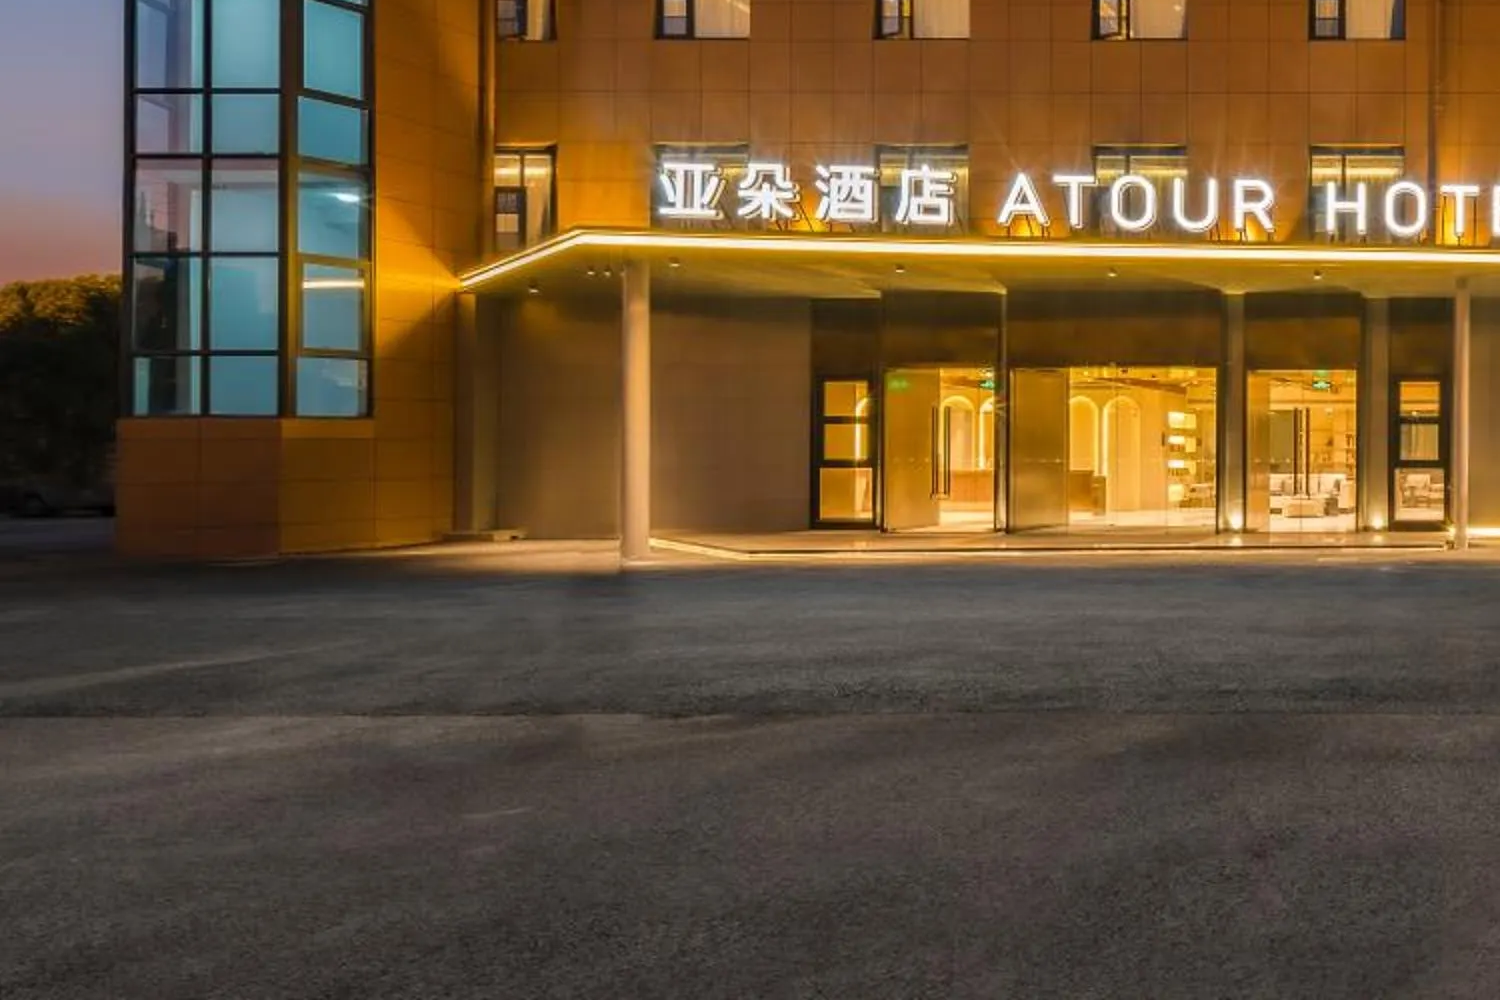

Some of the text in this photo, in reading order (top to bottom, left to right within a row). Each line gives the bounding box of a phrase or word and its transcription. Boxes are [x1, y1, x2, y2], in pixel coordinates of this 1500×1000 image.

[657, 161, 957, 226] 亚朵酒店
[997, 172, 1276, 233] ATOUR
